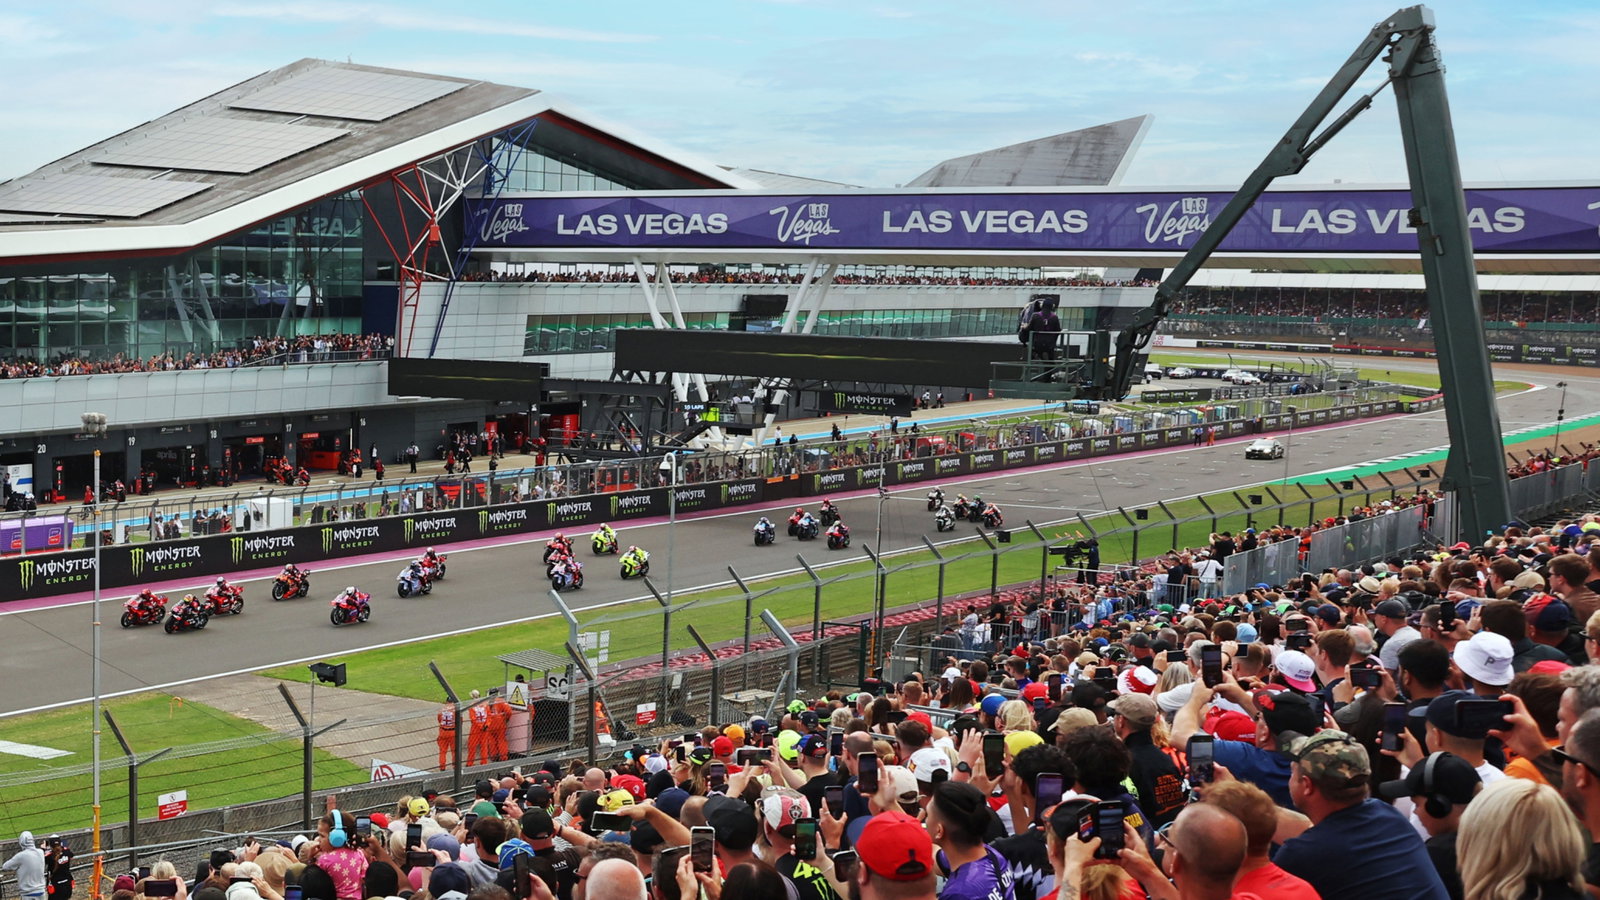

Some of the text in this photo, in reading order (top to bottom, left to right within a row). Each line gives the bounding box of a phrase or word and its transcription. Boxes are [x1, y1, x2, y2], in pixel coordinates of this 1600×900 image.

[505, 204, 523, 217] LAS
[809, 204, 829, 218] LAS
[1182, 198, 1207, 213] LAS
[557, 213, 728, 235] LAS VEGAS
[769, 205, 841, 245] Vegas
[882, 209, 1088, 233] LAS VEGAS
[1136, 205, 1211, 245] Vegas
[1271, 207, 1525, 234] LAS VEAS
[847, 395, 895, 406] MONSTER
[210, 429, 218, 439] 18
[285, 423, 292, 432] 17
[128, 436, 136, 446] 19
[37, 443, 47, 454] 20
[675, 489, 706, 501] MONSTER
[728, 483, 757, 495] MONSTER
[619, 495, 651, 507] MONSTER
[557, 501, 592, 515] MONSTER
[489, 509, 527, 524] MONSTER
[561, 514, 587, 522] ENERGY
[415, 517, 457, 532] MONSTER
[494, 522, 521, 530] ENERGY
[333, 525, 380, 542] MONSTER
[421, 531, 451, 540] ENERGY
[244, 535, 295, 552] MONSTER
[340, 540, 374, 549] ENERGY
[146, 545, 201, 564] MONSTER
[252, 550, 288, 560] ENERGY
[36, 557, 96, 577] MONSTER
[154, 561, 194, 571] ENERGY
[46, 574, 89, 585] ENERGY
[548, 676, 568, 696] SC
